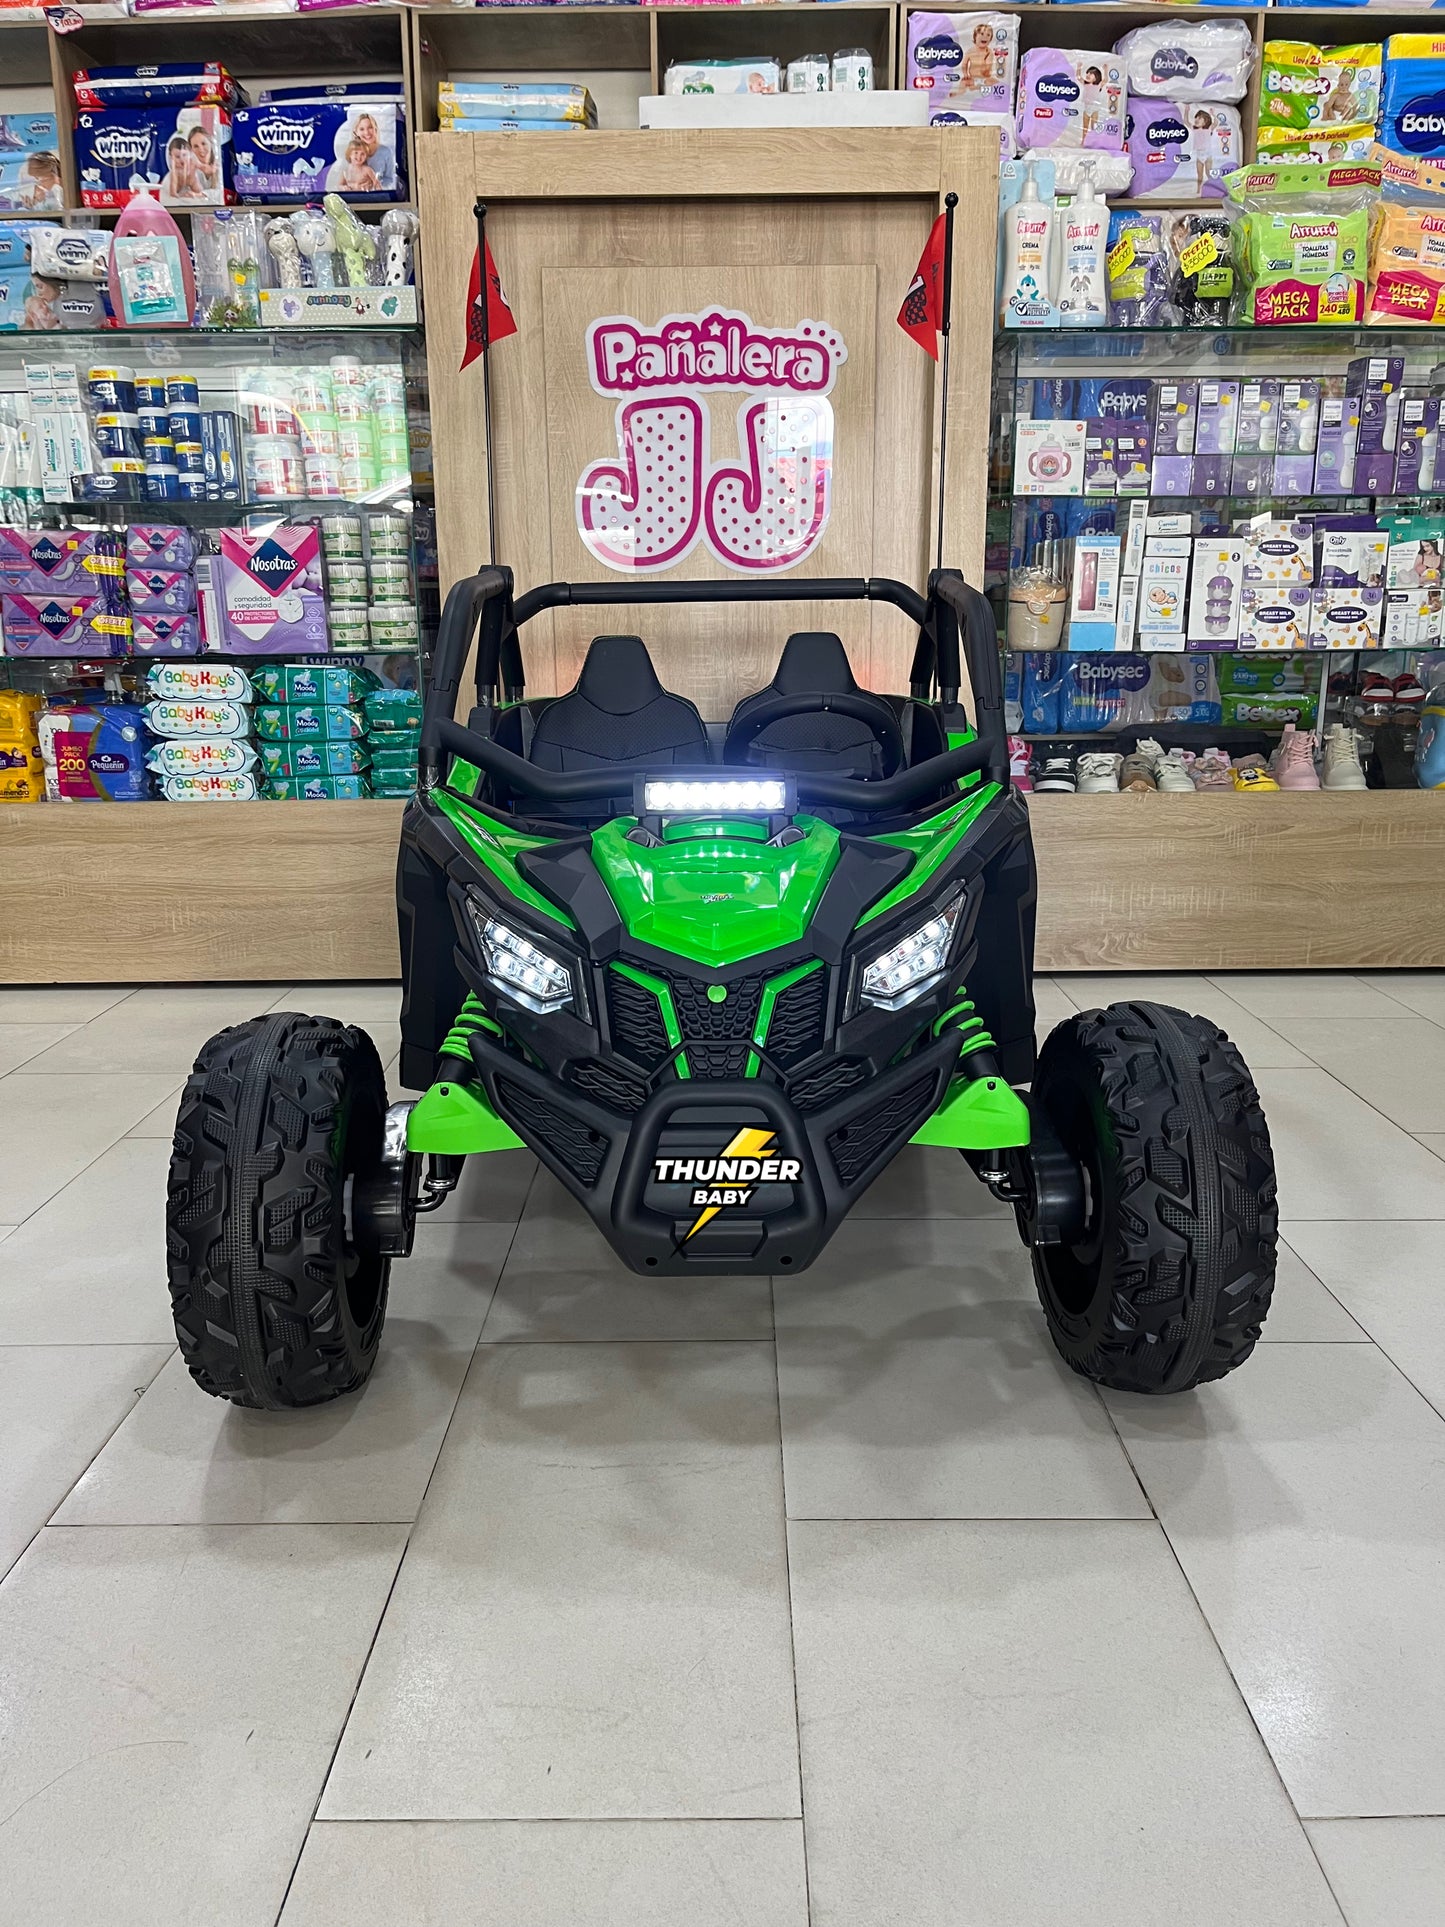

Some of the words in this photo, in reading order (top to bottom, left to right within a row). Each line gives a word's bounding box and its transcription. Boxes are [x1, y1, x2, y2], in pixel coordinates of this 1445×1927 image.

[917, 47, 959, 60] Babysec
[1038, 82, 1077, 95] Babysec
[1268, 70, 1329, 94] Bebex
[993, 86, 1005, 94] XG
[261, 123, 312, 147] winny
[1149, 129, 1186, 139] Babysec
[100, 134, 149, 160] winny
[1332, 171, 1356, 179] MEGA
[1359, 168, 1381, 180] PACK
[1384, 160, 1417, 180] Arrurrú
[257, 177, 268, 186] 50
[1290, 222, 1338, 239] Arrurrú
[60, 247, 89, 260] winny
[1182, 238, 1209, 261] OFERTA
[1388, 281, 1430, 298] MEGA
[1270, 291, 1310, 305] MEGA
[1391, 294, 1428, 310] PACK
[63, 302, 93, 313] winny
[1273, 304, 1309, 318] PACK
[1320, 303, 1338, 313] 240
[601, 326, 824, 384] Pañalera
[1103, 391, 1147, 411] Babys
[582, 397, 826, 568] JJ
[1329, 536, 1347, 545] Only
[31, 548, 62, 559] Nosotras
[251, 555, 296, 571] Nosotras
[1149, 561, 1181, 573] chicos
[40, 613, 70, 624] Nosotras
[98, 617, 127, 626] OFERTA
[231, 611, 243, 621] 40
[1079, 662, 1144, 680] Babysec
[164, 670, 198, 687] Baby
[200, 672, 235, 687] Kay's
[294, 684, 317, 692] Moody
[159, 705, 193, 722] Baby
[195, 706, 230, 722] Kay's
[1237, 703, 1299, 722] Bebex
[296, 719, 318, 728] Moody
[166, 746, 200, 762] Baby
[201, 746, 236, 761] Kay's
[59, 759, 86, 771] 200
[91, 760, 125, 770] Pequeñín
[298, 757, 320, 765] Moody
[174, 777, 209, 792] Baby
[211, 777, 245, 790] Kay's
